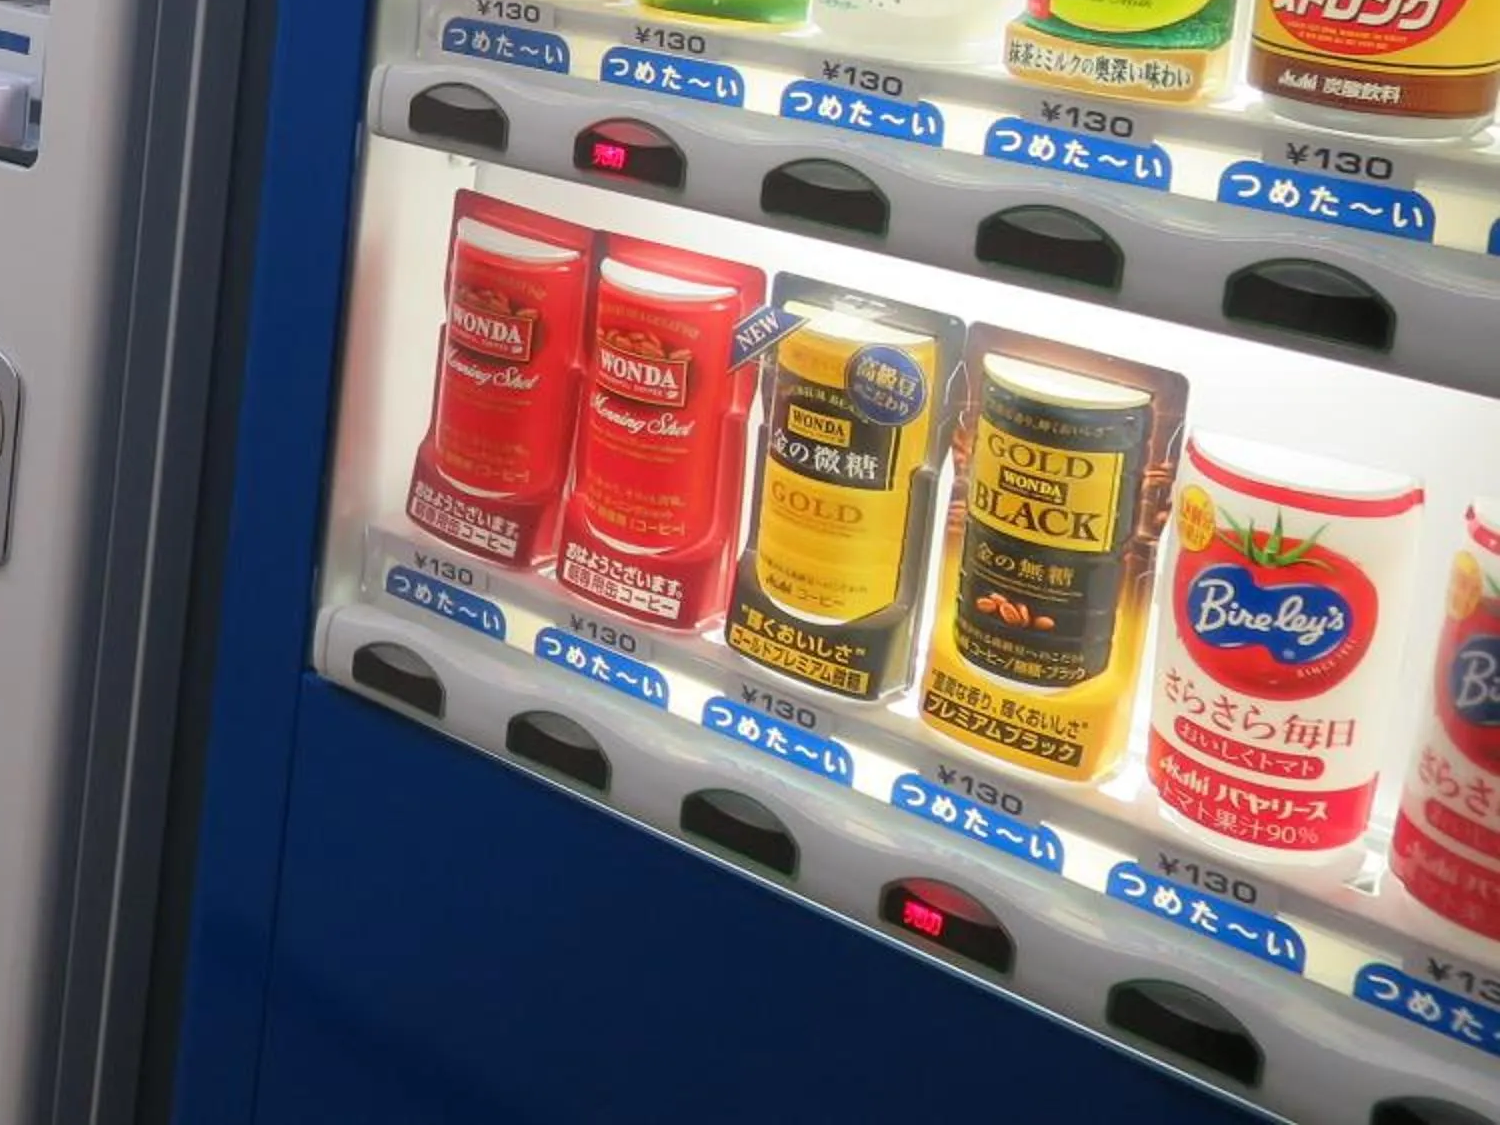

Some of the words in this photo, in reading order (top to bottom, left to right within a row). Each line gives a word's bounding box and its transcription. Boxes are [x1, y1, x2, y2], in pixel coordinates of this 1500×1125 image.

[634, 25, 707, 54] ¥130
[821, 60, 904, 97] ¥130
[1040, 100, 1135, 139] ¥130
[1285, 141, 1394, 181] ¥130
[450, 305, 523, 345] WONDA
[734, 310, 782, 352] NEW
[600, 347, 679, 390] WONDA
[791, 409, 845, 437] WONDA
[986, 433, 1096, 480] GOLD
[770, 479, 864, 525] GOLD
[1002, 469, 1063, 498] WONDA
[973, 479, 1104, 542] BLACK
[413, 550, 474, 586] ¥130
[1194, 576, 1346, 645] Bireley's
[569, 613, 638, 654] ¥130
[740, 683, 819, 728] ¥130
[936, 763, 1025, 817] ¥130
[1158, 851, 1259, 905] ¥130
